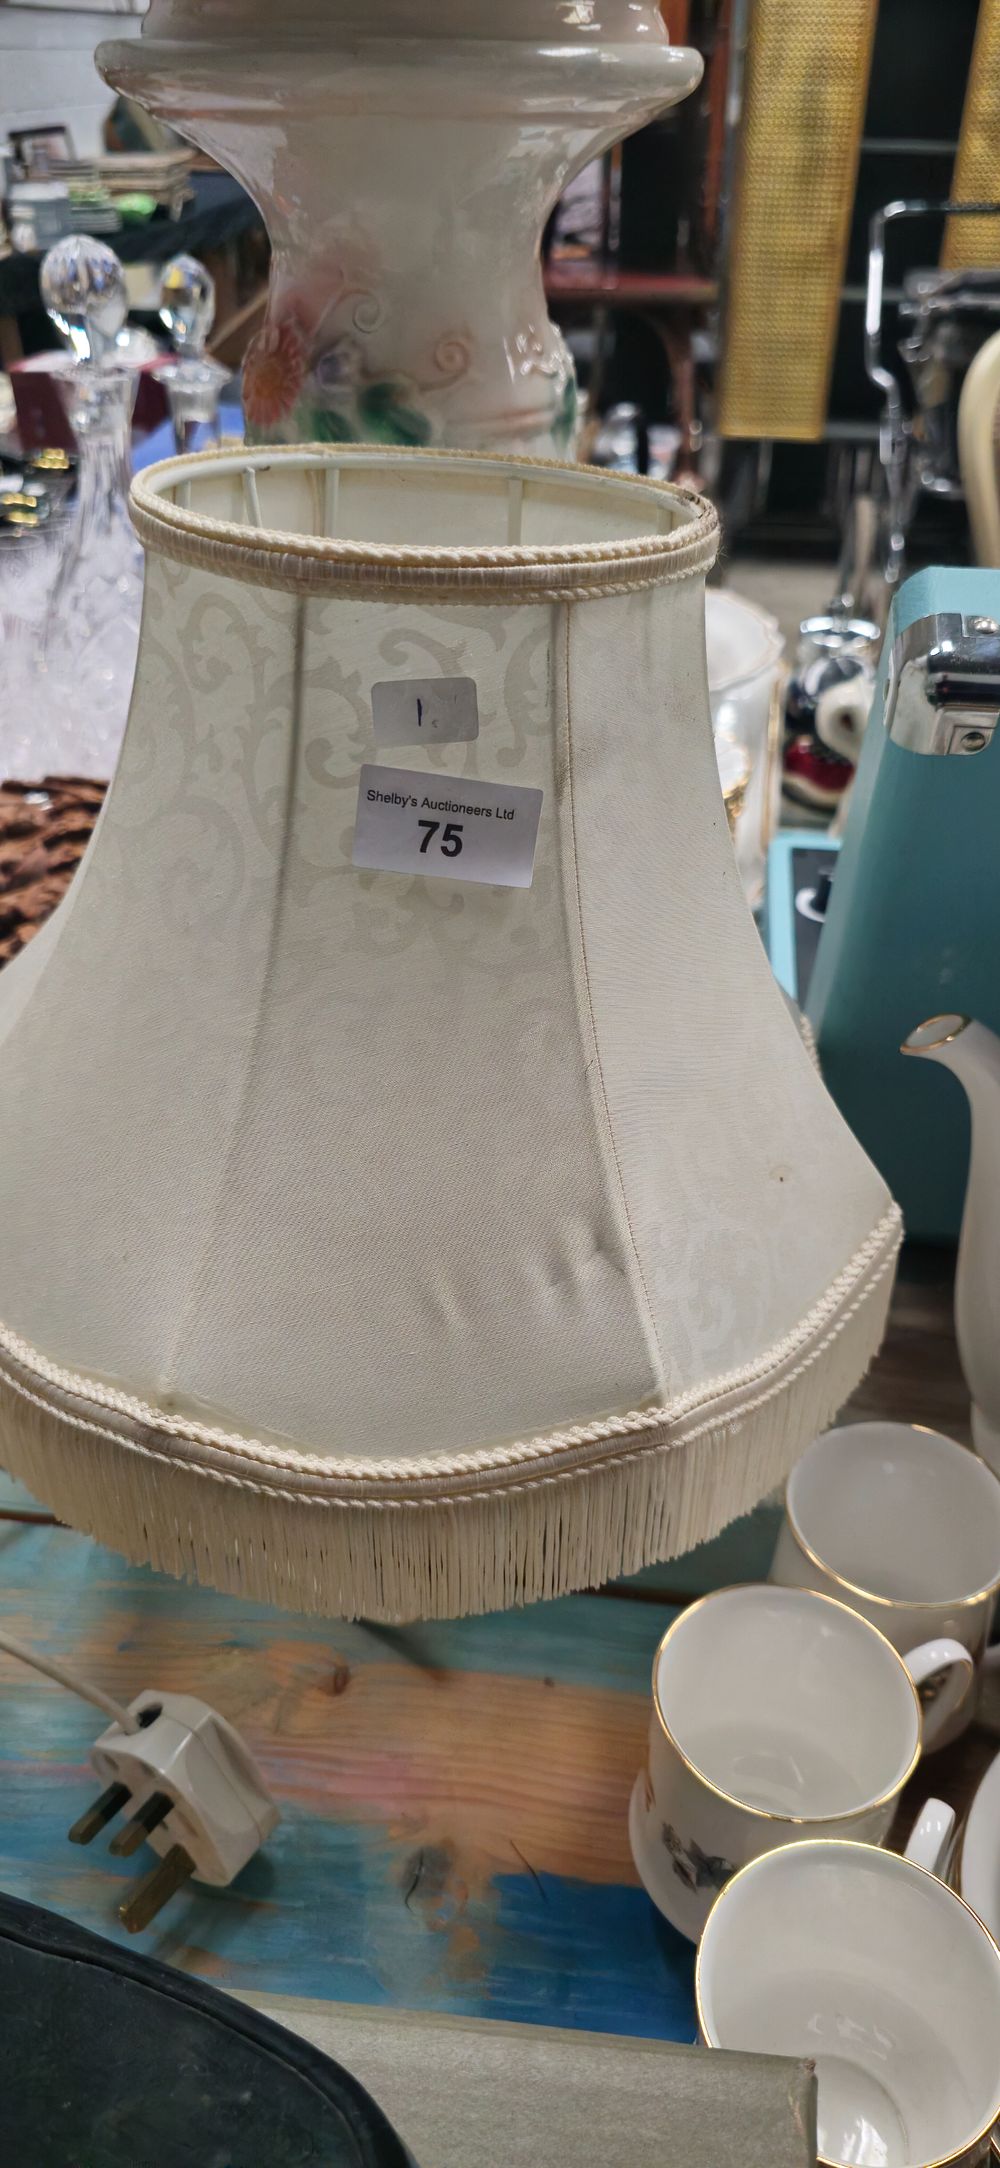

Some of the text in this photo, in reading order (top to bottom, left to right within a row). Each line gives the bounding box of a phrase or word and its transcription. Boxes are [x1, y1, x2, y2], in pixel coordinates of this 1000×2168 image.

[366, 789, 515, 820] Shelby's Auctioneers Ltd
[417, 819, 464, 858] 75
